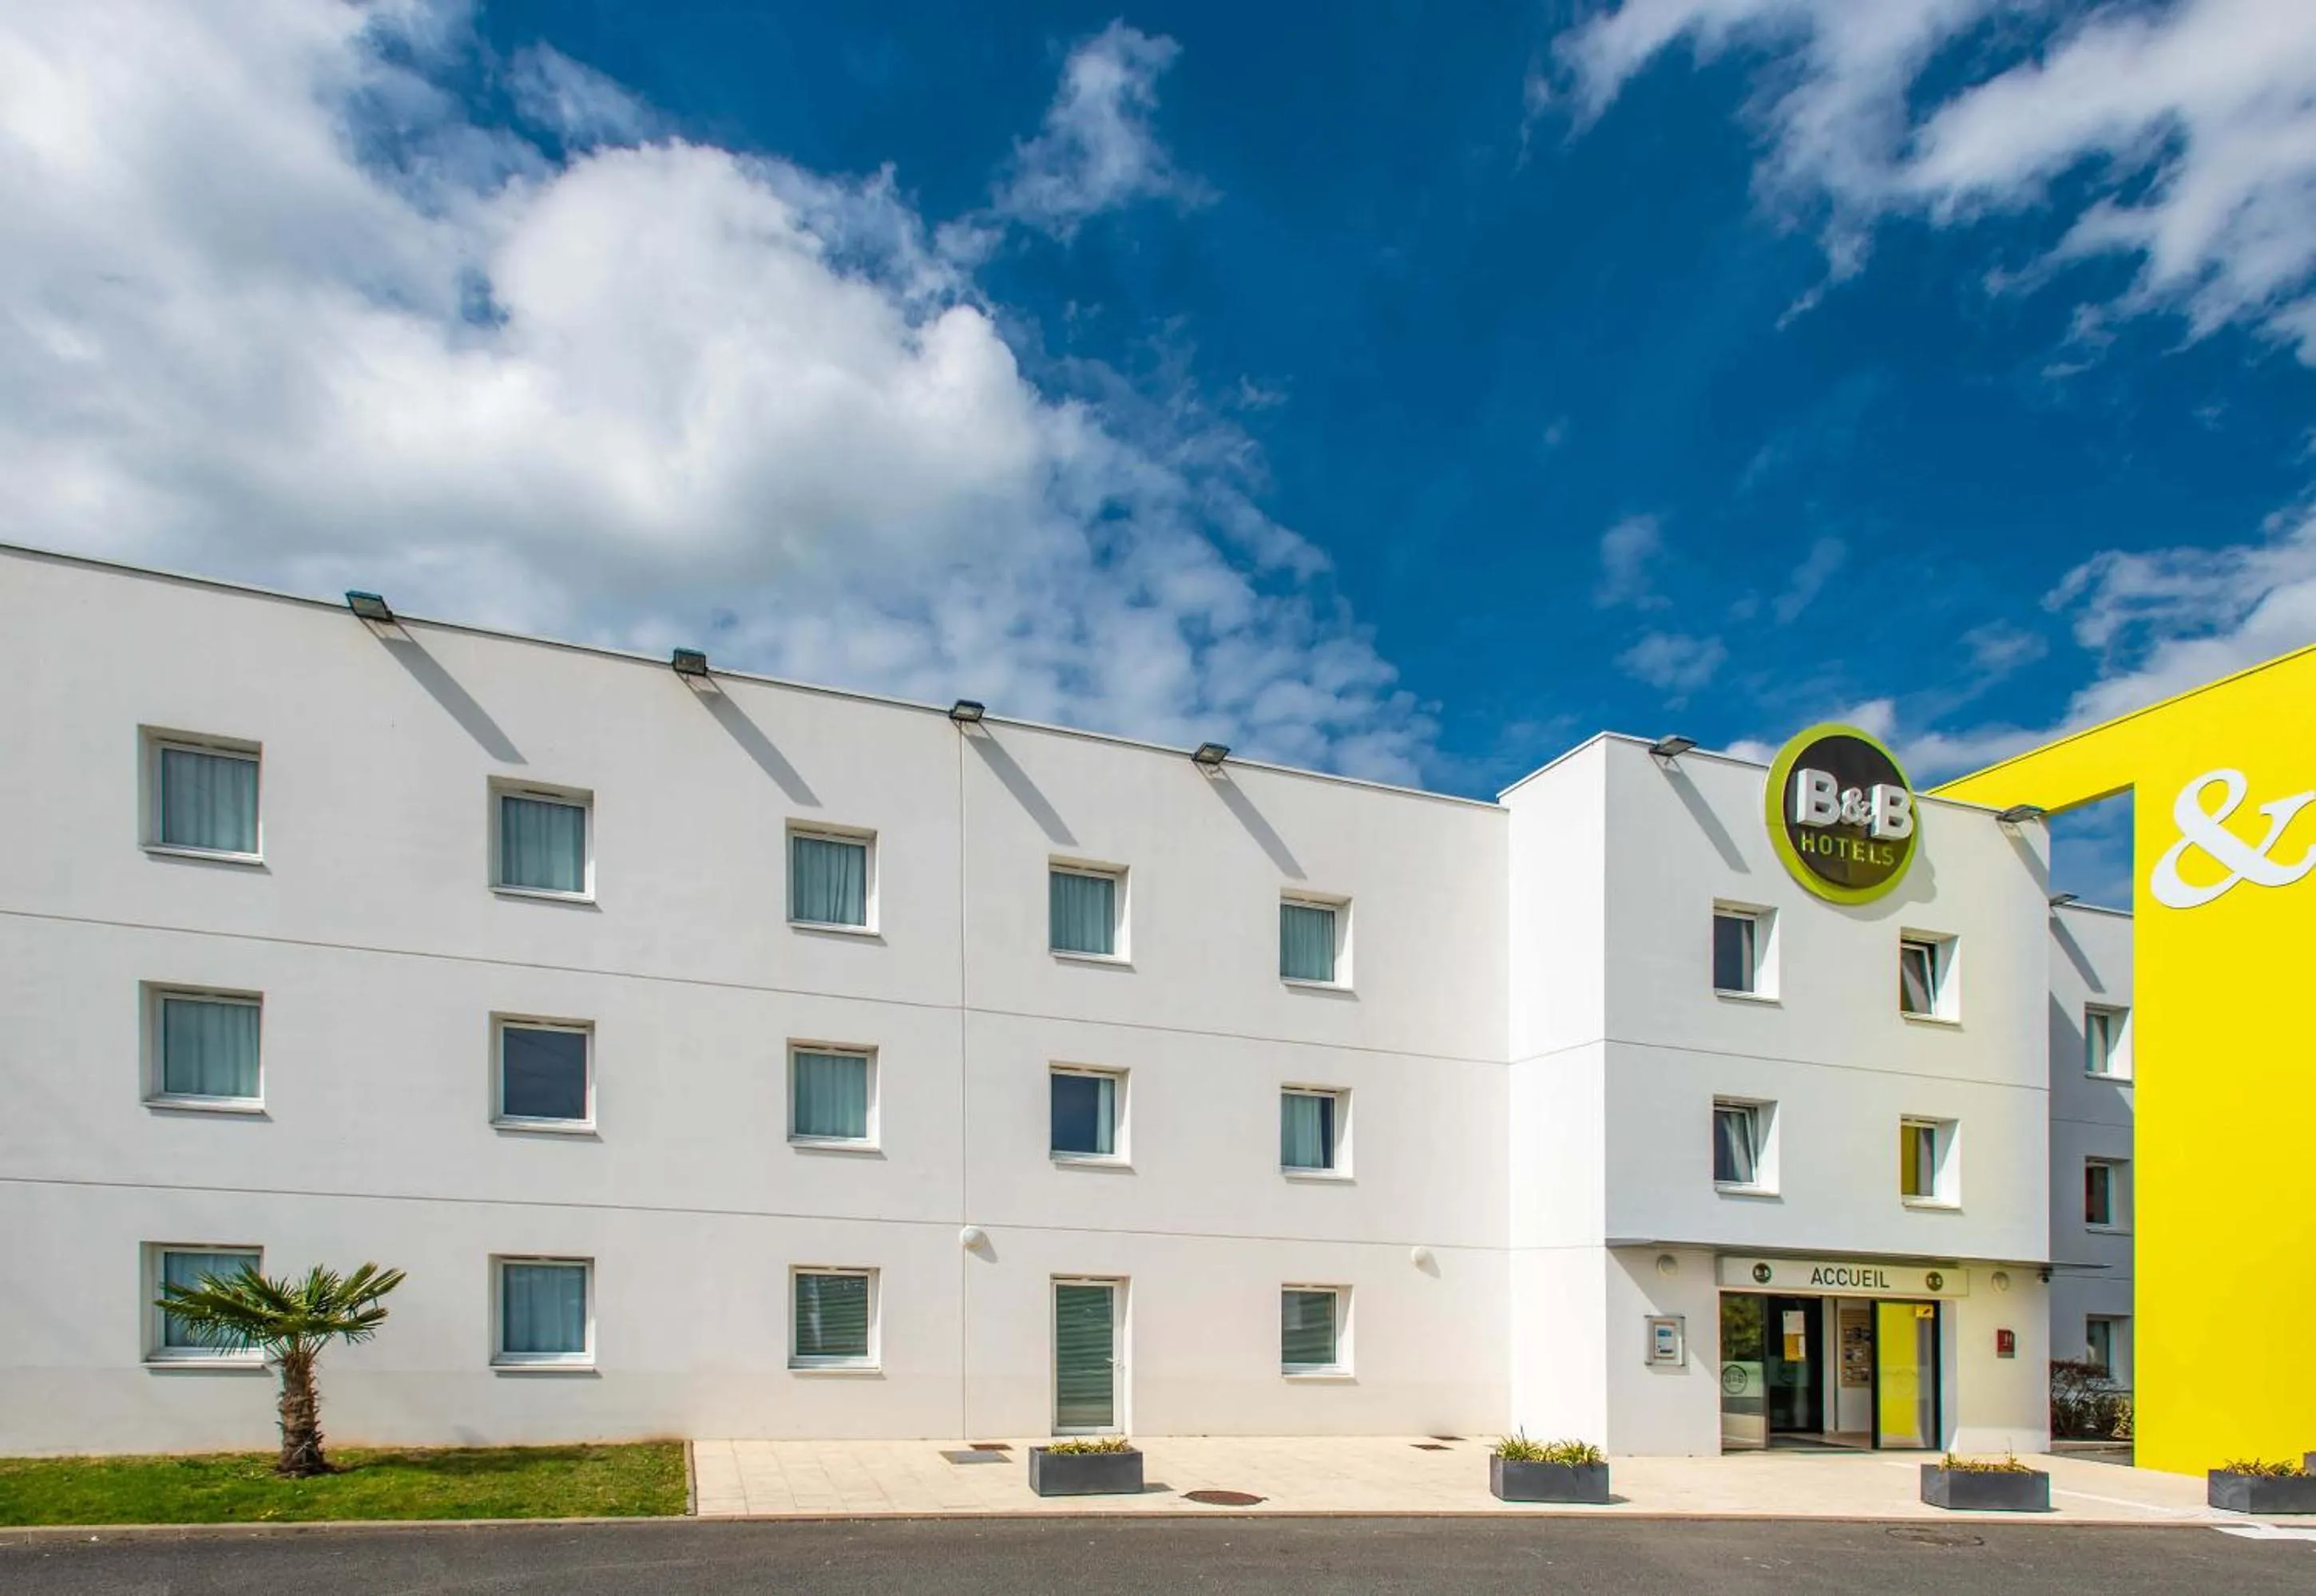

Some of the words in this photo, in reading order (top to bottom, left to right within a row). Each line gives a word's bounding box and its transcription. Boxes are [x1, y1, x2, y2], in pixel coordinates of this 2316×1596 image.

[1797, 768, 1913, 840] B&B
[1801, 831, 1895, 866] HOTELS
[2150, 767, 2316, 909] &
[1810, 1267, 1890, 1288] ACCUEIL
